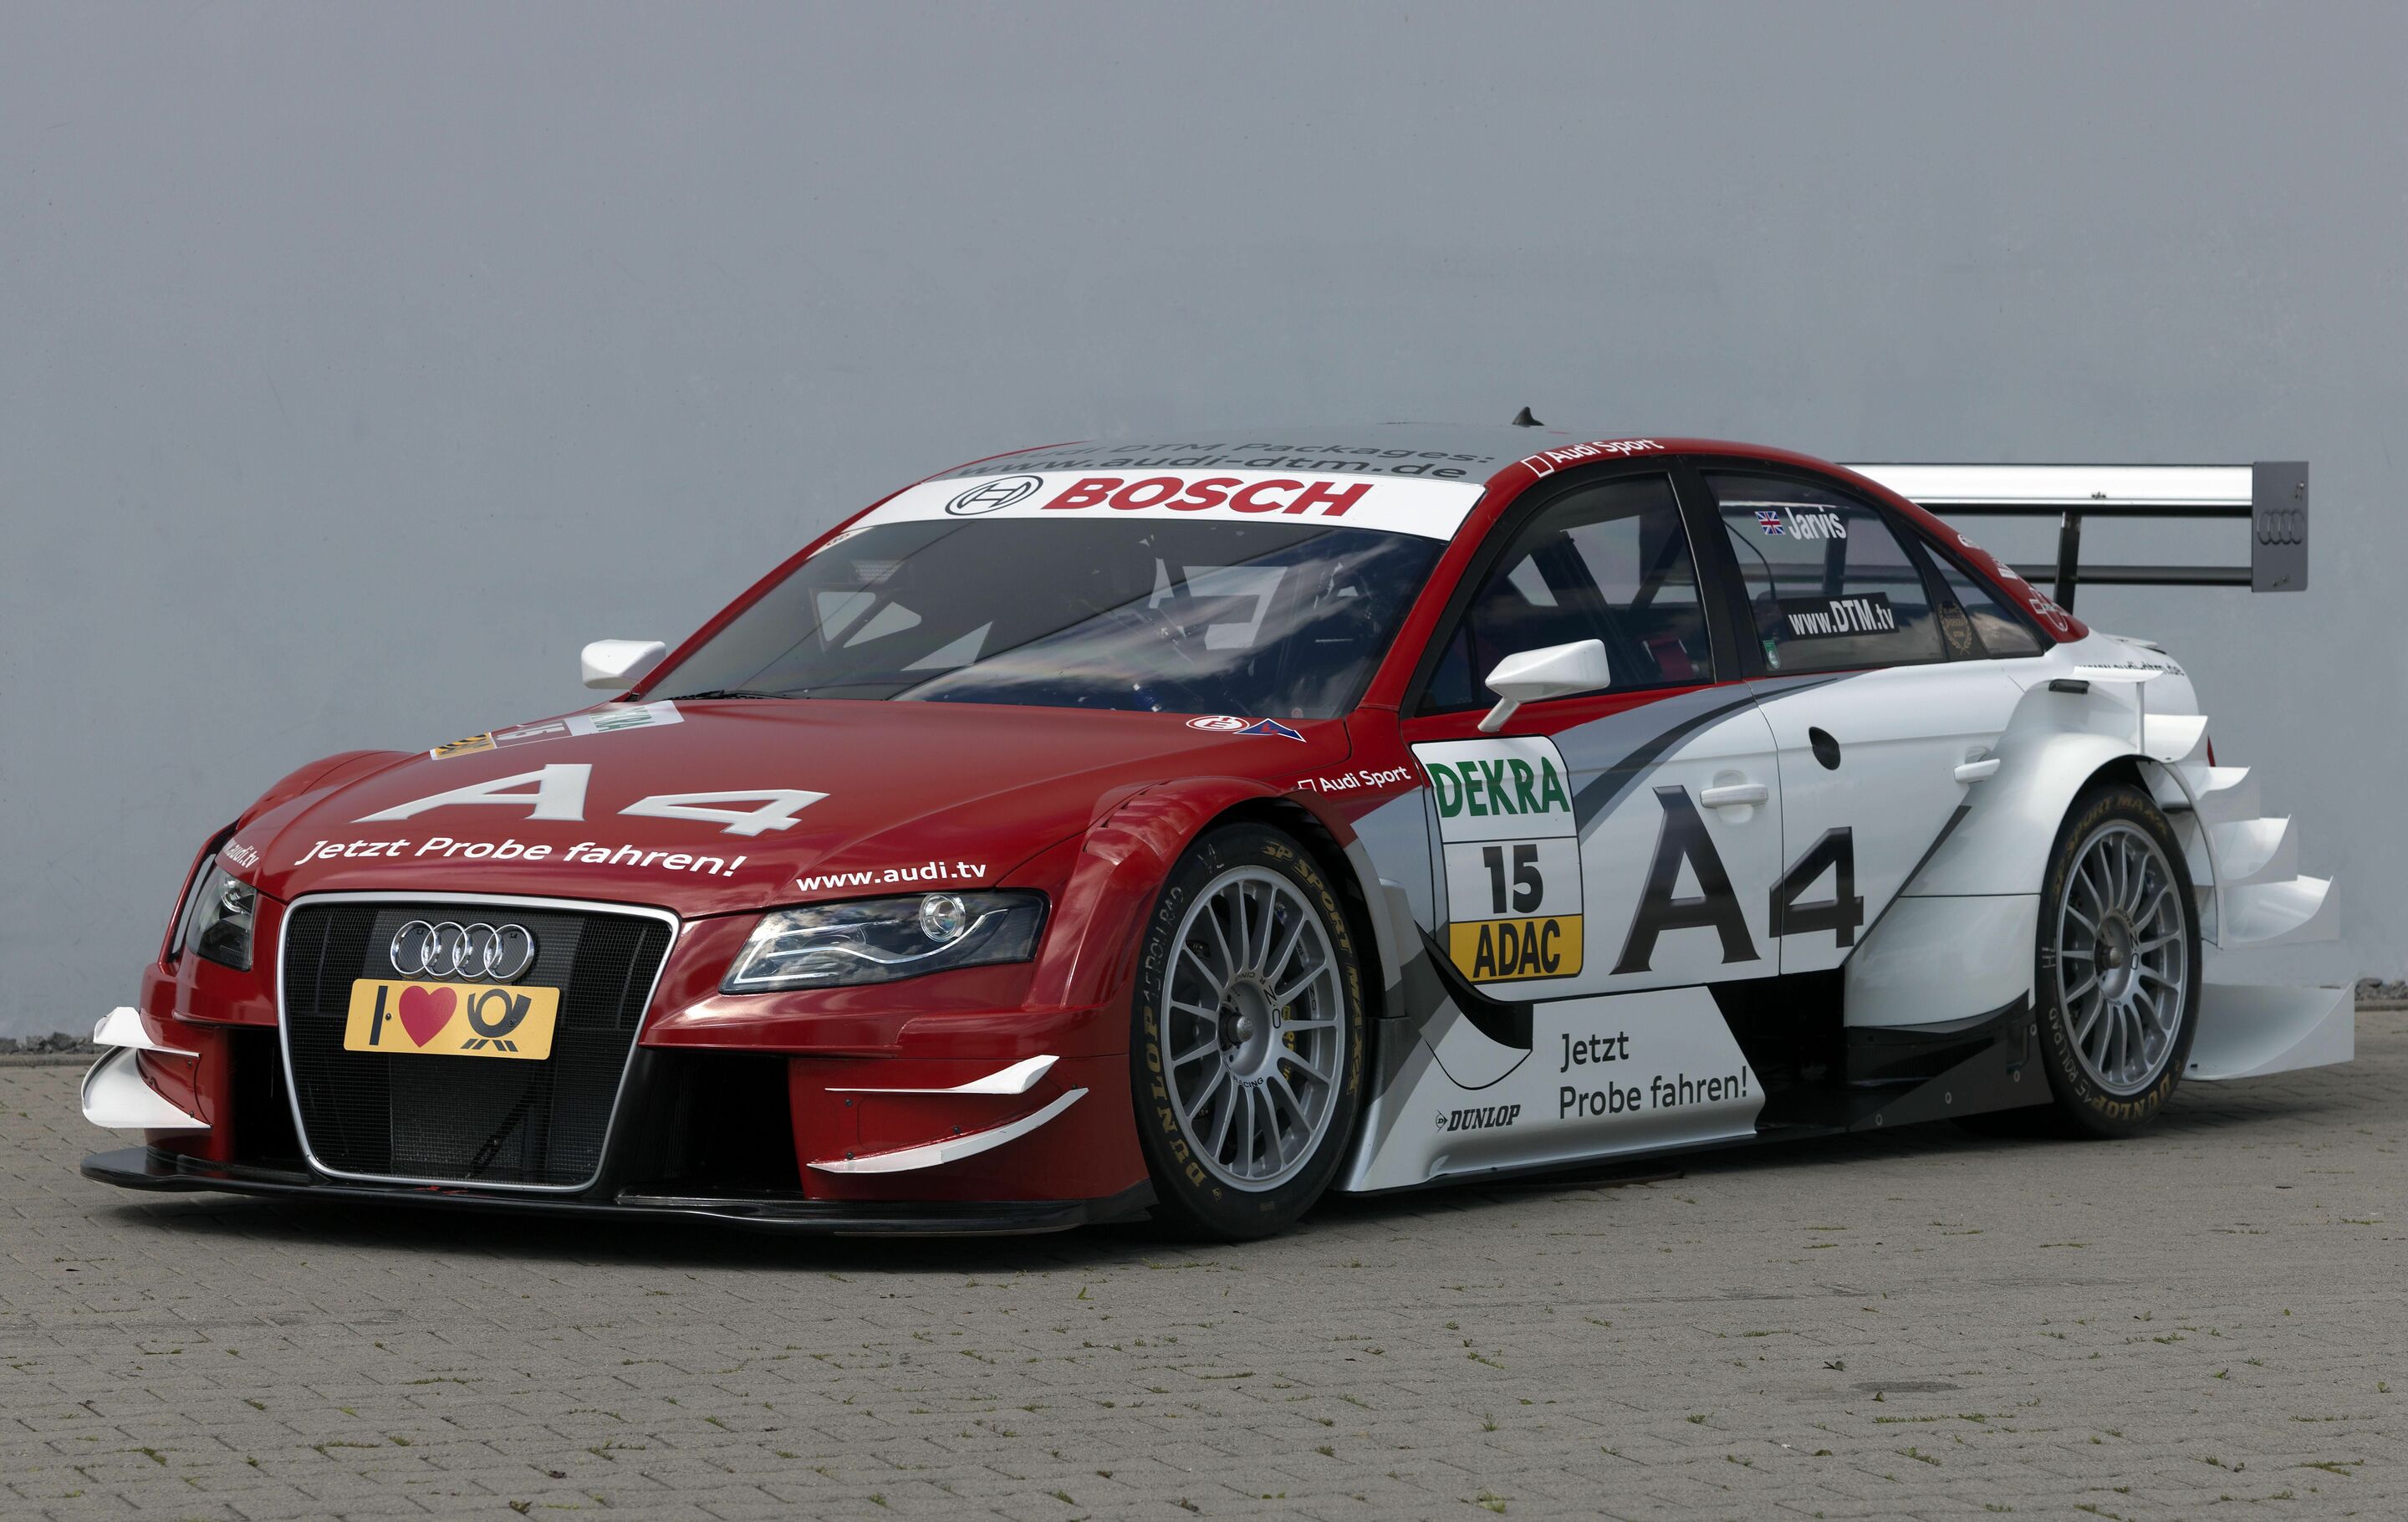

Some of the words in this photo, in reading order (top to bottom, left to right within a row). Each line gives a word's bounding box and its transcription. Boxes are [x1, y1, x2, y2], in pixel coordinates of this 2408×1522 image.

[958, 455, 1467, 478] www.audi-dtm.de
[1108, 442, 1226, 452] DTM
[1233, 442, 1496, 463] Packages:
[1545, 443, 1602, 462] Audi
[1592, 439, 1666, 456] Sport
[1040, 477, 1374, 517] BOSCH
[1784, 506, 1847, 540] Jarvis
[1788, 599, 1895, 636] www.DTM.tv
[1319, 773, 1360, 792] Audi
[1360, 766, 1411, 788] Sport
[1426, 756, 1571, 818] DEKRA
[293, 839, 411, 866] Jetzt
[414, 837, 548, 861] Probe
[563, 842, 747, 877] fahren!
[796, 861, 987, 891] www.audi.tv
[1482, 844, 1543, 914] 15
[1610, 785, 1865, 974] A4
[1261, 839, 1294, 864] SP
[1290, 858, 1354, 958] SPORT
[1344, 964, 1366, 1096] MAXX
[1472, 919, 1561, 978] ADAC
[1560, 1031, 1630, 1073] Jetzt
[1143, 1005, 1207, 1188] DUNLOP
[1559, 1080, 1641, 1119] Probe
[1650, 1065, 1748, 1109] fahren!
[2091, 1071, 2172, 1121] DUNLOP
[1446, 1105, 1521, 1131] DUNLOP
